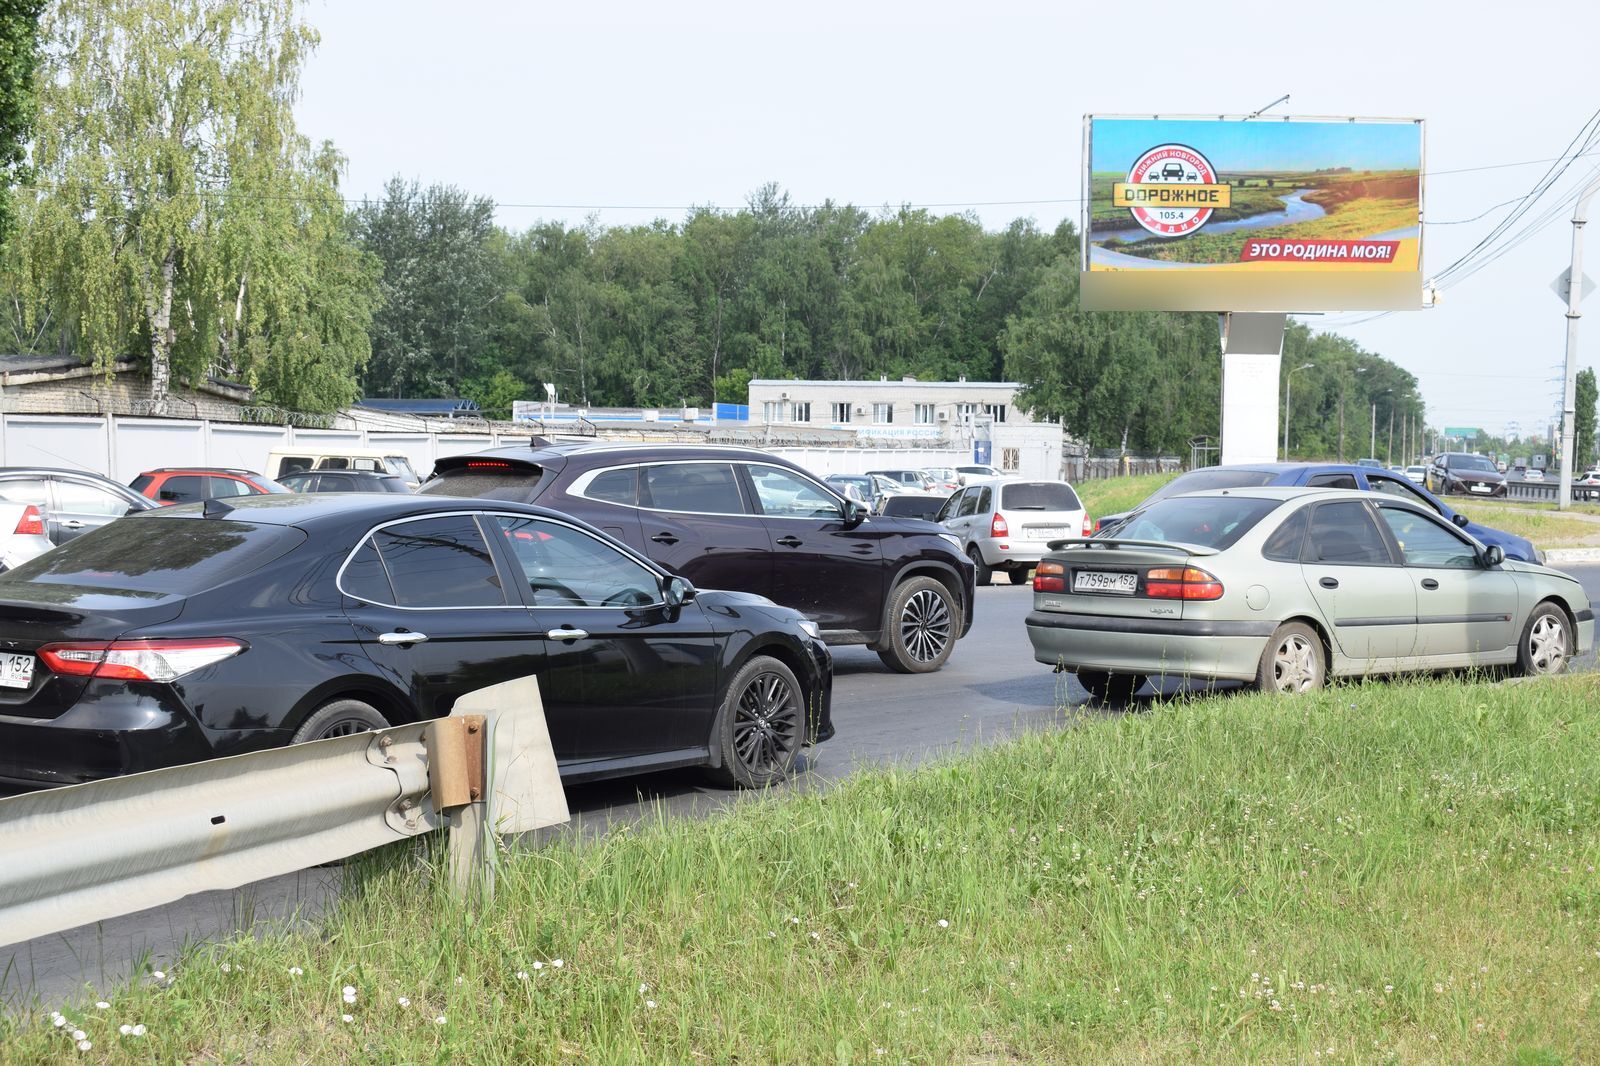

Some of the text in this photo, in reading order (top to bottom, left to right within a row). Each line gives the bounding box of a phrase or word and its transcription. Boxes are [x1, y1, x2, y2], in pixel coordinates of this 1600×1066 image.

[1137, 150, 1207, 176] НИЖНИЙ НОВГОРОД
[1124, 189, 1220, 202] ДОРОЖНОЕ
[1159, 211, 1185, 220] 105.4
[1143, 216, 1200, 233] РАДИО
[1250, 244, 1392, 260] ЭТО РОДИНА МОЯ!
[1118, 574, 1135, 586] 152
[9, 656, 31, 673] 152
